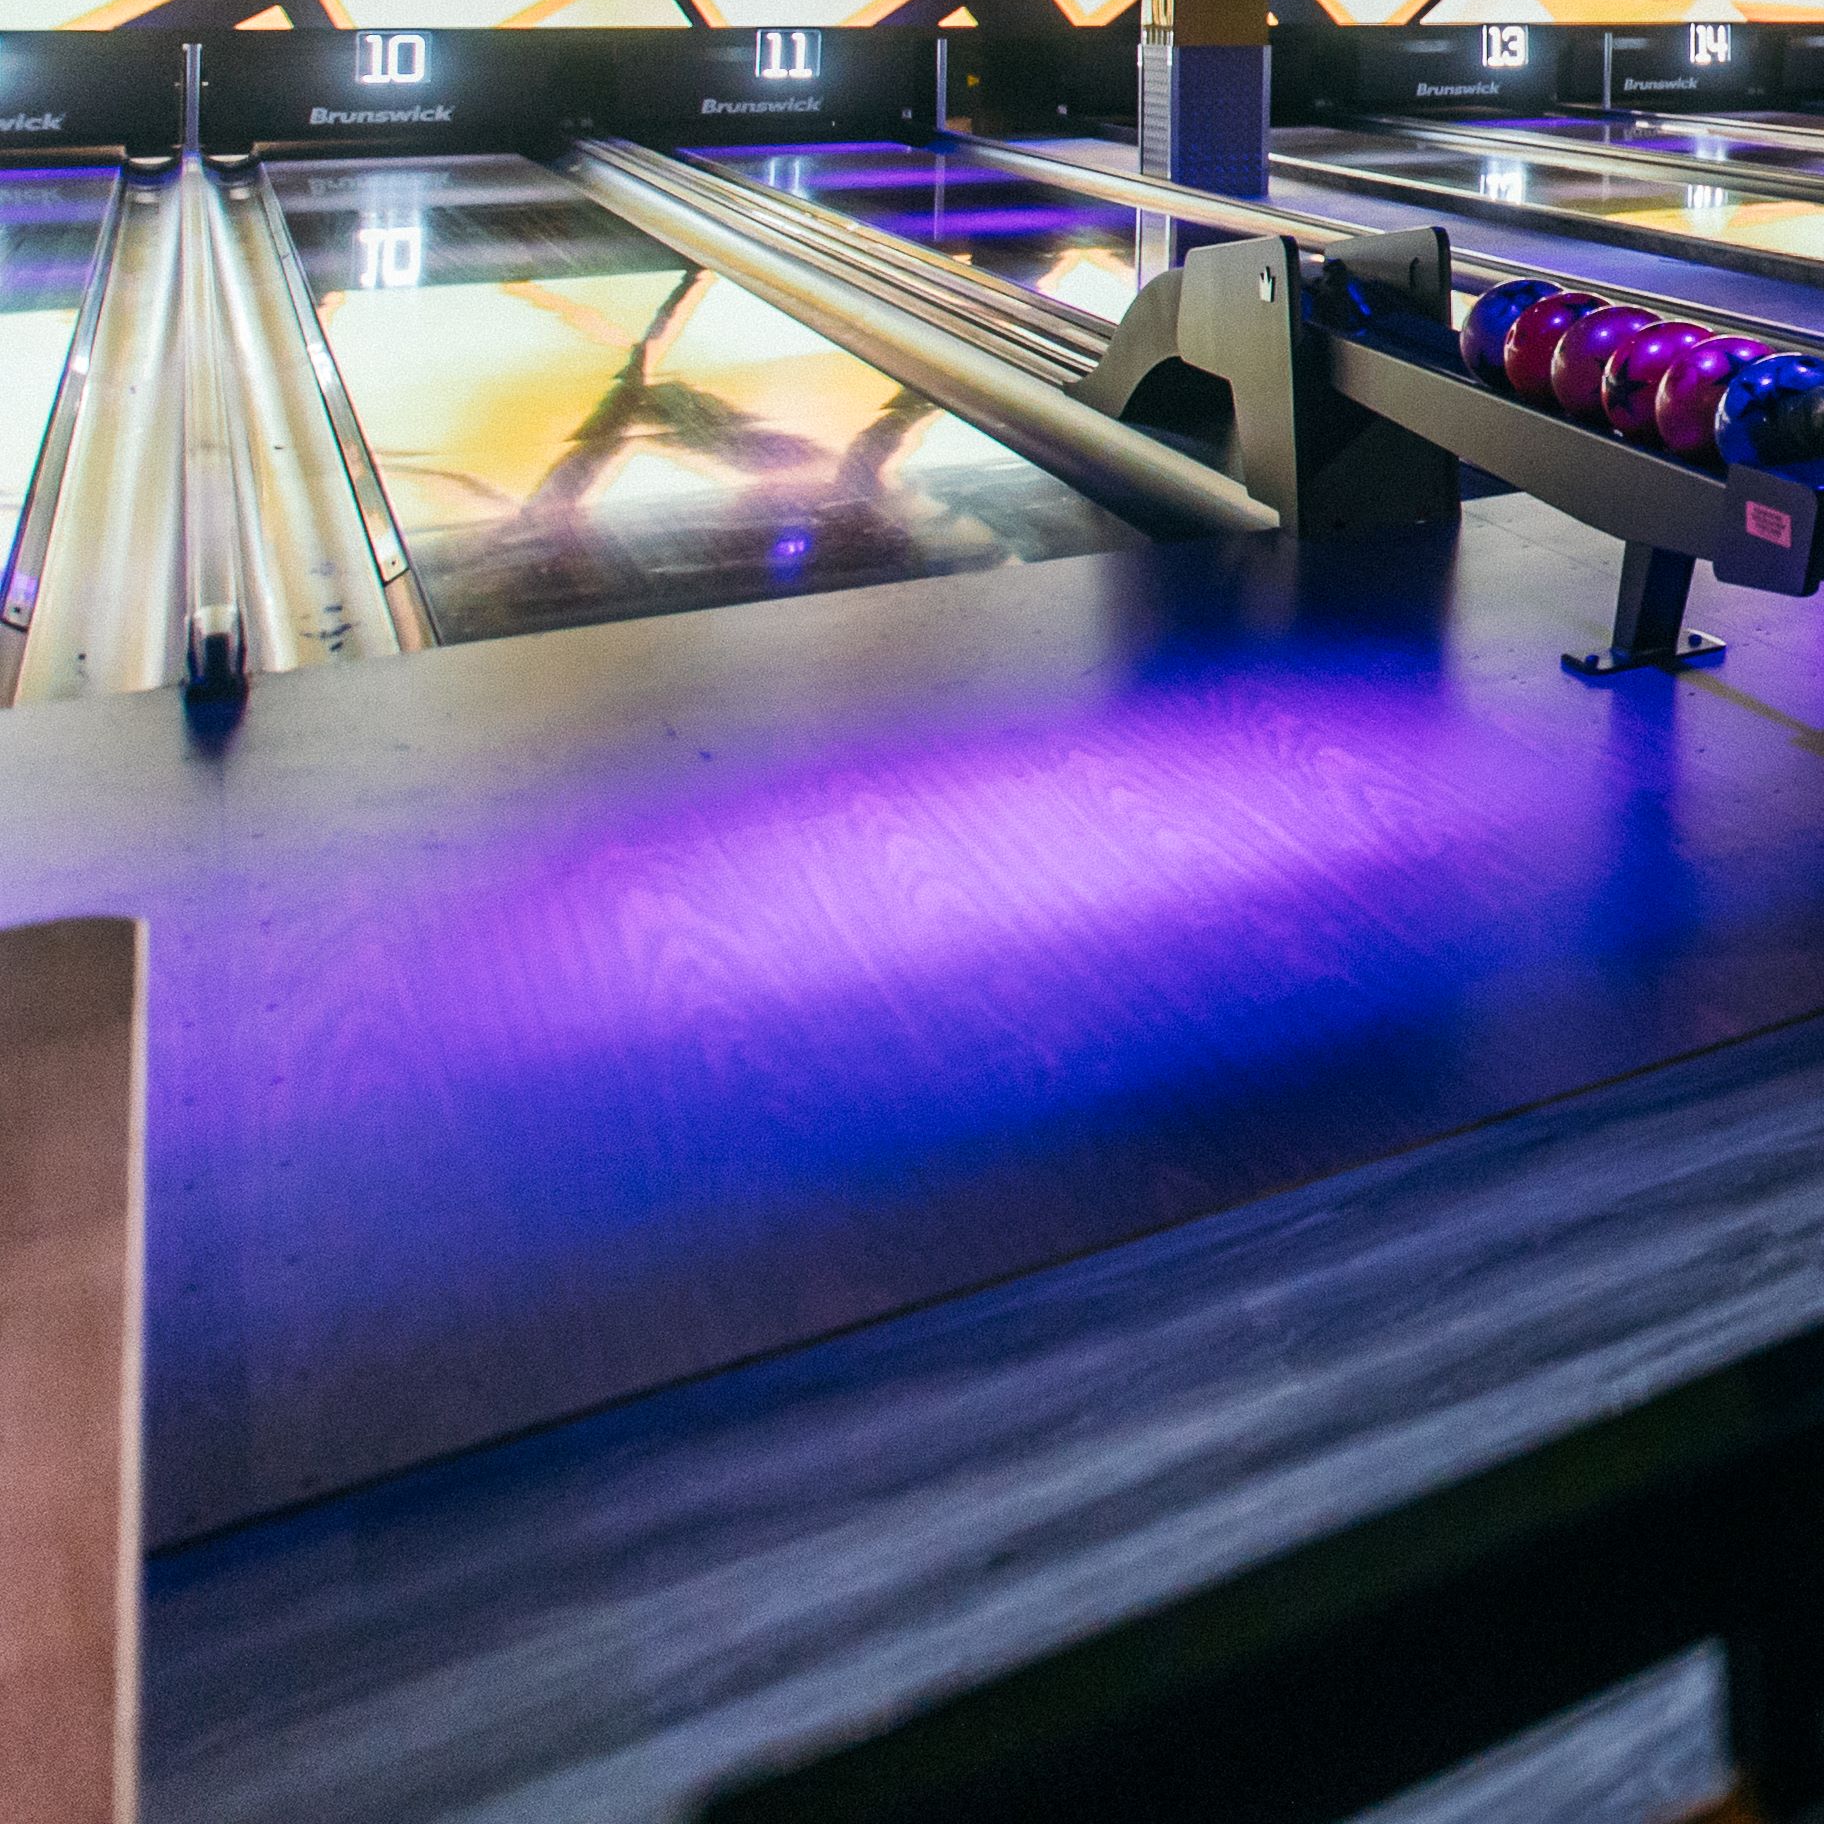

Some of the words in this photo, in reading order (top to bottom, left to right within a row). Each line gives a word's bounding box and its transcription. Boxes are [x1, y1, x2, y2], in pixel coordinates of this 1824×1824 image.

[361, 34, 426, 84] 10
[762, 32, 813, 80] 11
[1487, 25, 1526, 67] 13
[1695, 25, 1729, 66] 14
[1416, 81, 1500, 96] Brunswick
[1624, 77, 1698, 92] Brunswick
[309, 105, 456, 126] Brunswick
[701, 96, 822, 114] Brunswick
